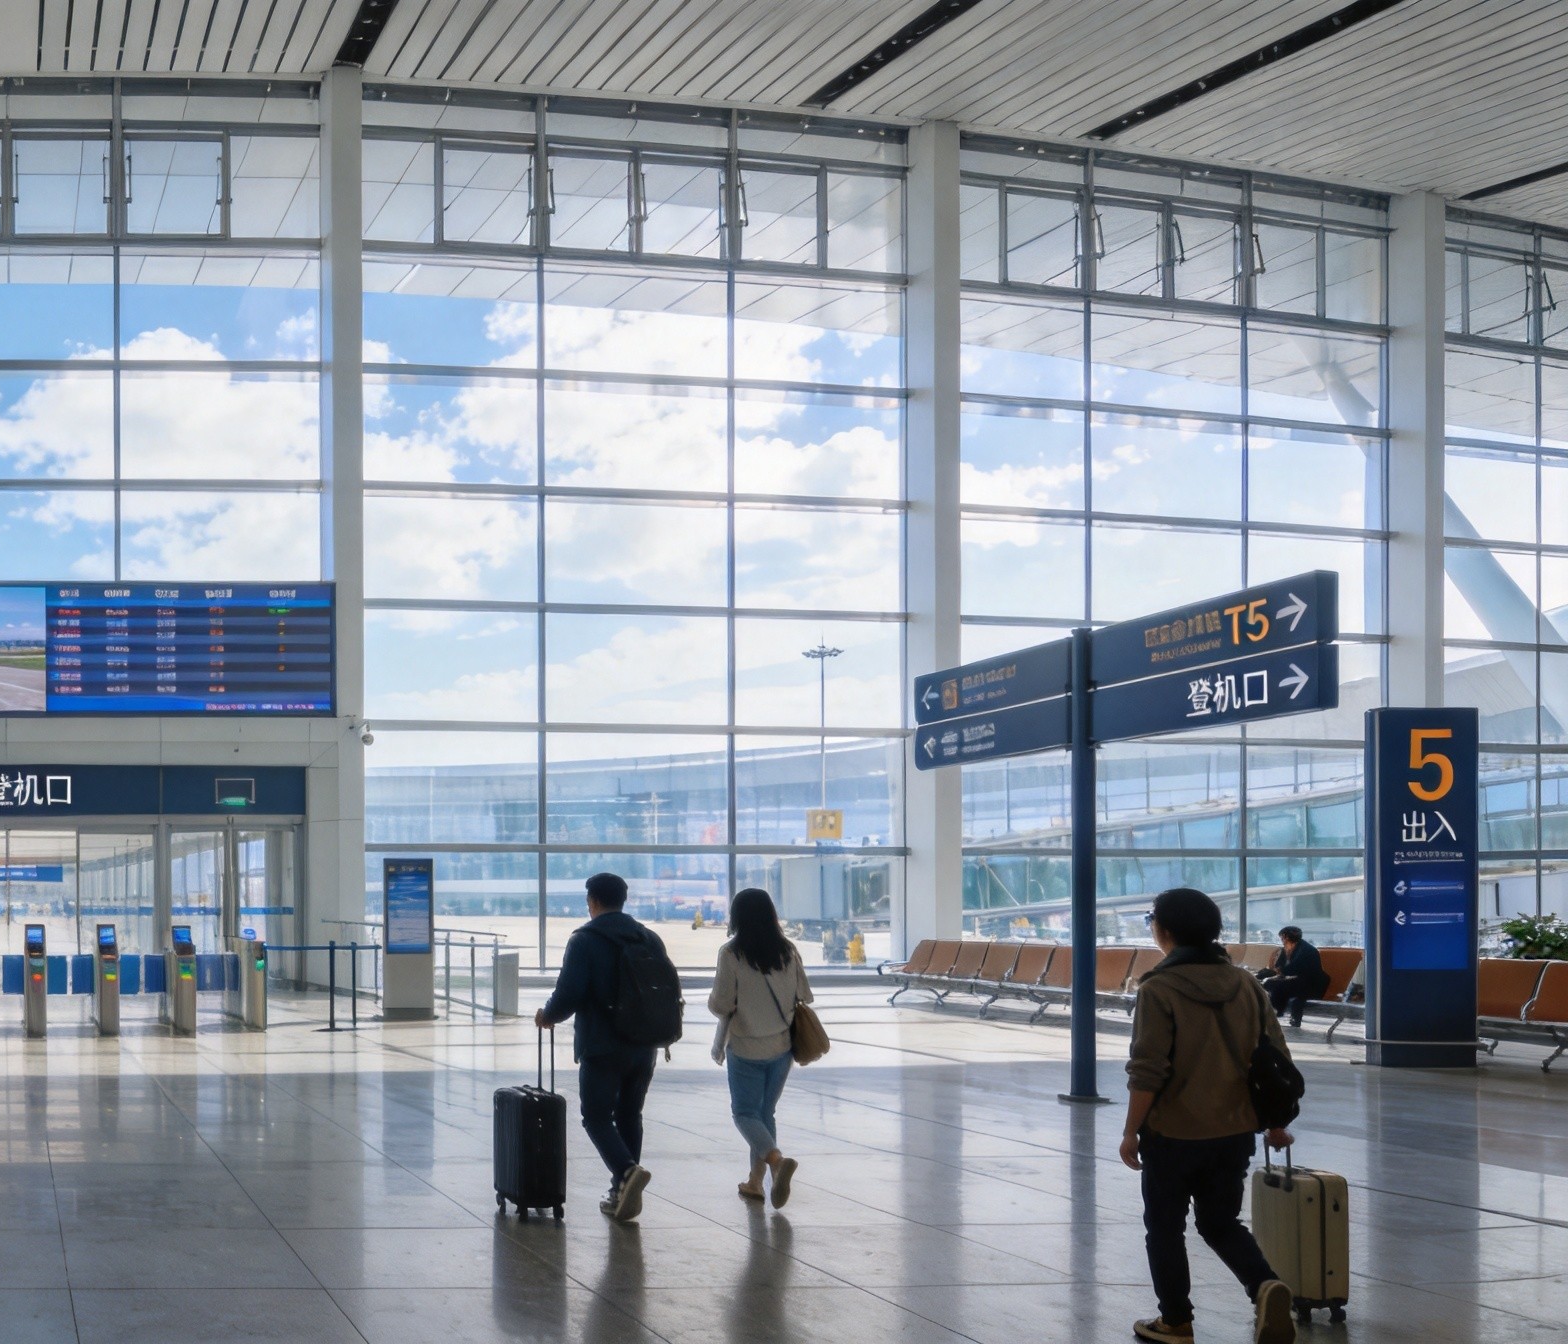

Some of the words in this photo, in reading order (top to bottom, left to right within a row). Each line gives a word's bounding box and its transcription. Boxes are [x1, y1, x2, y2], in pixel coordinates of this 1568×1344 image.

[1223, 598, 1270, 645] T5
[1185, 669, 1269, 718] 登机口
[1407, 728, 1454, 802] 5
[1401, 810, 1457, 843] 出入
